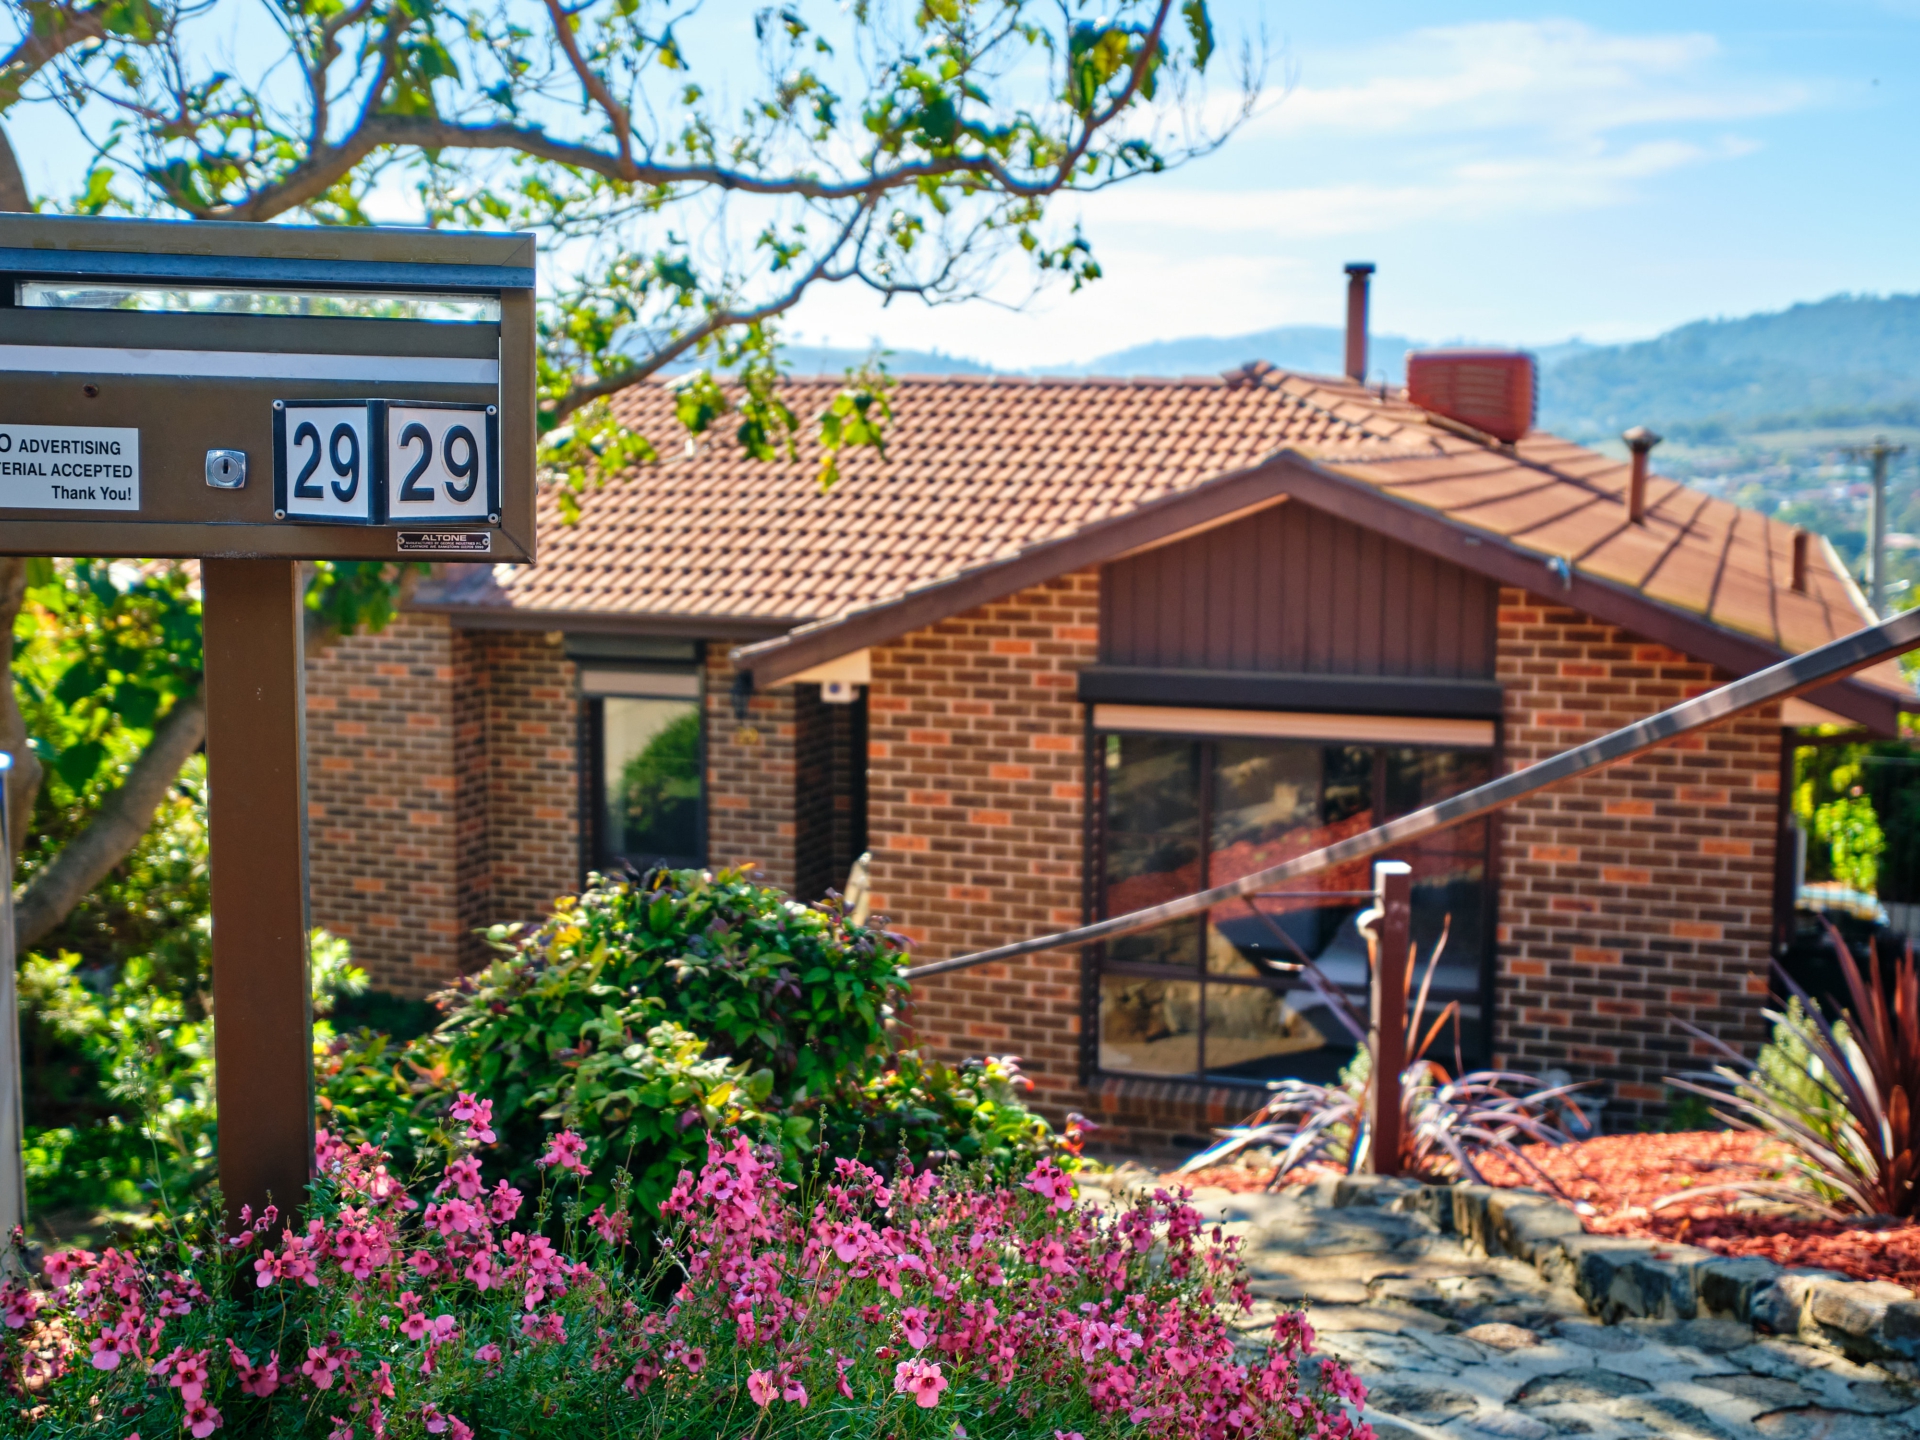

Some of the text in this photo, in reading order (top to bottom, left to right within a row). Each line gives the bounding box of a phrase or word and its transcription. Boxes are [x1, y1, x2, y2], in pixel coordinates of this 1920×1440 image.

[0, 433, 121, 455] O ADVERTISING
[0, 461, 133, 478] ERIAL ACCEPTED
[294, 421, 360, 503] 29
[398, 421, 479, 503] 29
[52, 485, 131, 501] Thank You!
